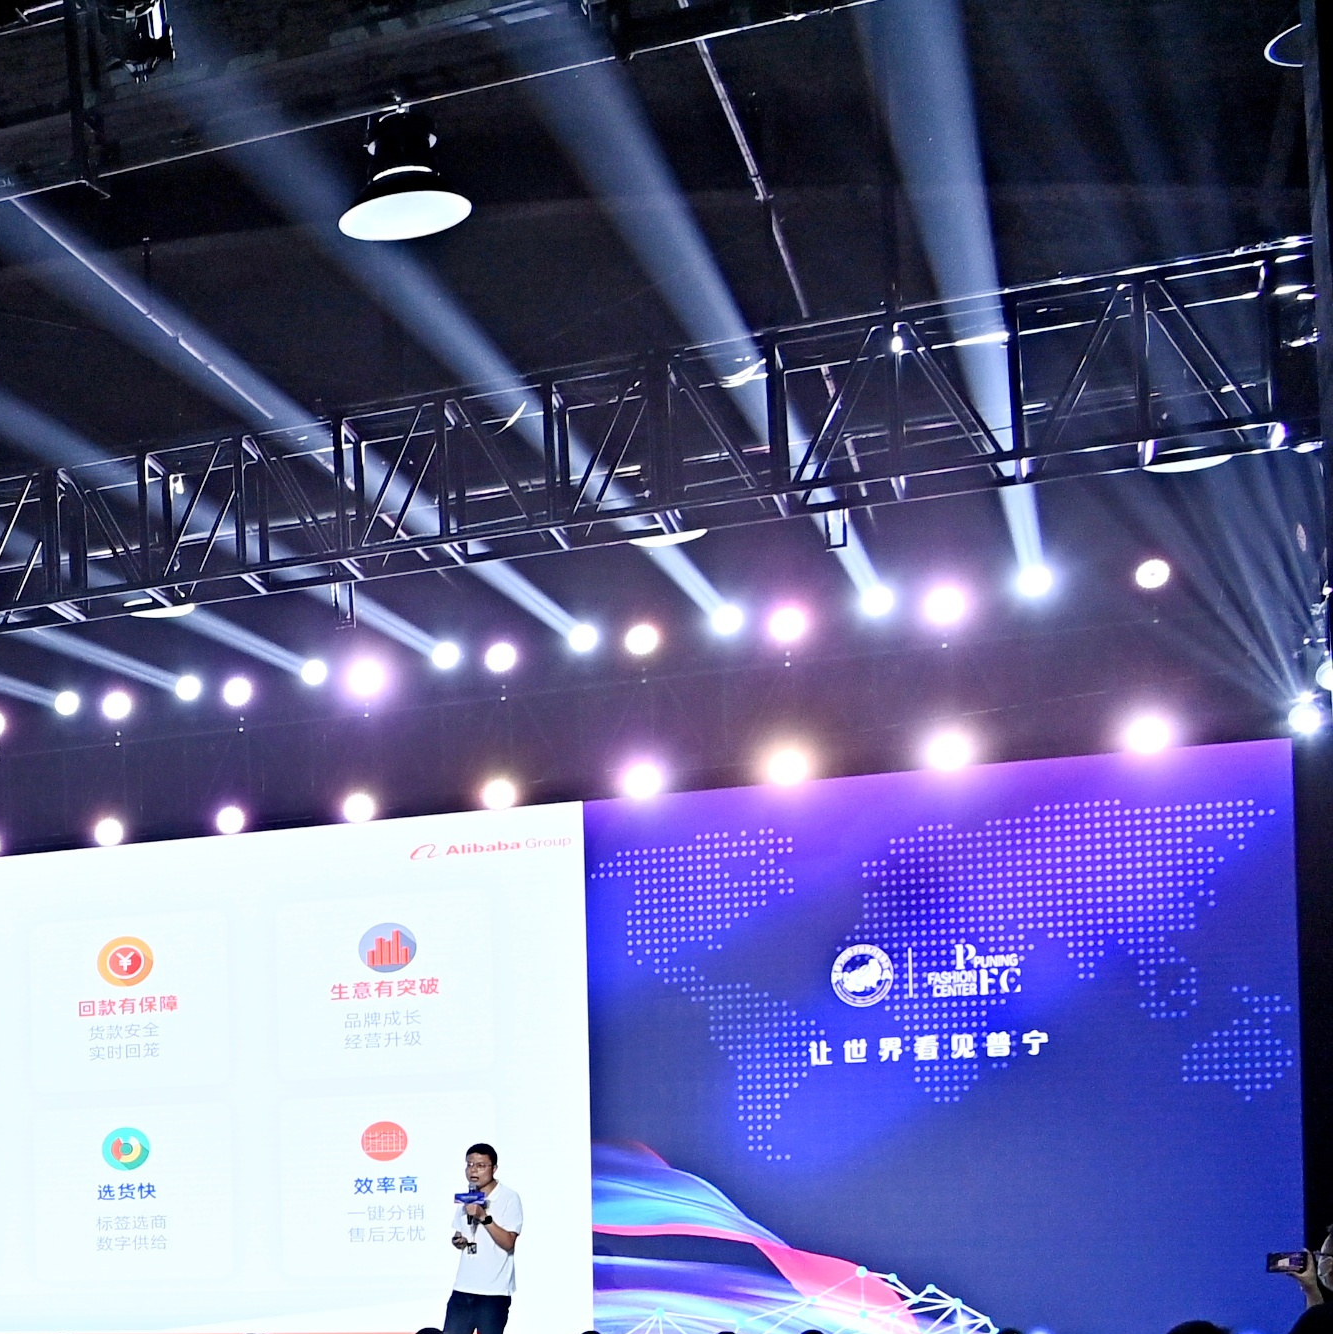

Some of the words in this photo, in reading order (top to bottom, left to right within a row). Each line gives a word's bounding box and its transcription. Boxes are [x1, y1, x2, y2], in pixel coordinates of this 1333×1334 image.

[445, 838, 522, 856] Alibaba
[524, 834, 572, 852] Group
[927, 970, 977, 986] FASHION
[330, 976, 440, 1002] 生意有突破
[933, 983, 978, 998] CENTER
[78, 994, 179, 1018] 回款有保障
[344, 1009, 422, 1029] 品牌成长
[88, 1021, 160, 1041] 货款安全
[344, 1030, 423, 1050] 经营升级
[88, 1041, 161, 1061] 实时回笼
[808, 1029, 1049, 1066] 让世界看见普宁
[97, 1182, 157, 1201] 选货快
[353, 1175, 419, 1195] 效率高
[96, 1214, 168, 1232] 标签选商
[347, 1204, 425, 1223] 一键分销
[96, 1234, 168, 1252] 数字供给
[348, 1224, 426, 1244] 售后无忧
